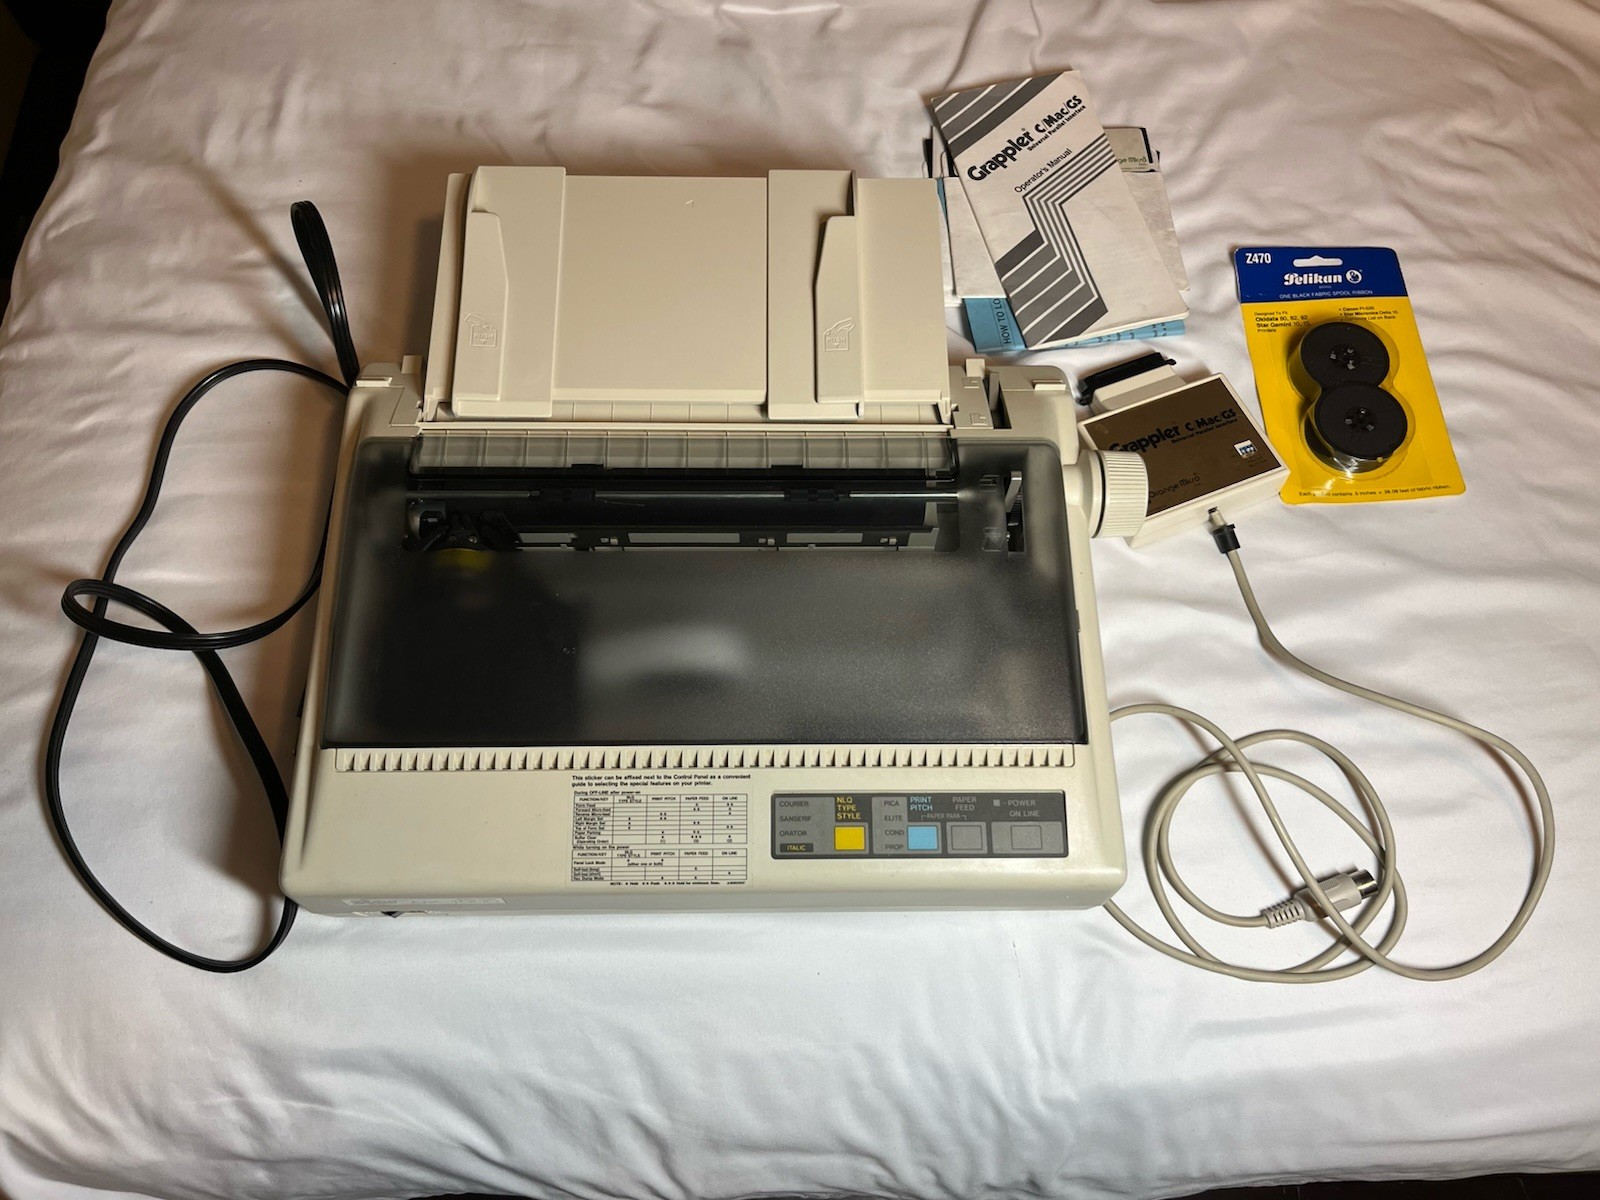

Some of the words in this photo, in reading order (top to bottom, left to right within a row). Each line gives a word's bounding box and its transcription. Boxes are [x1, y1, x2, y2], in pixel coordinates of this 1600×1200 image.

[1026, 134, 1050, 152] Universal
[1047, 121, 1067, 136] Parallel
[1064, 105, 1087, 123] Interface
[967, 130, 1035, 181] Grappler
[1034, 94, 1083, 133] C/Mac/GS
[1014, 165, 1050, 193] Operator's
[1046, 147, 1073, 169] Manual
[1245, 252, 1272, 264] Z470
[1283, 272, 1342, 286] Pelikan
[996, 311, 1006, 323] TO
[1000, 325, 1012, 345] HOW
[1149, 484, 1179, 499] Orange
[1007, 799, 1036, 807] POWER
[837, 812, 861, 820] STYLE
